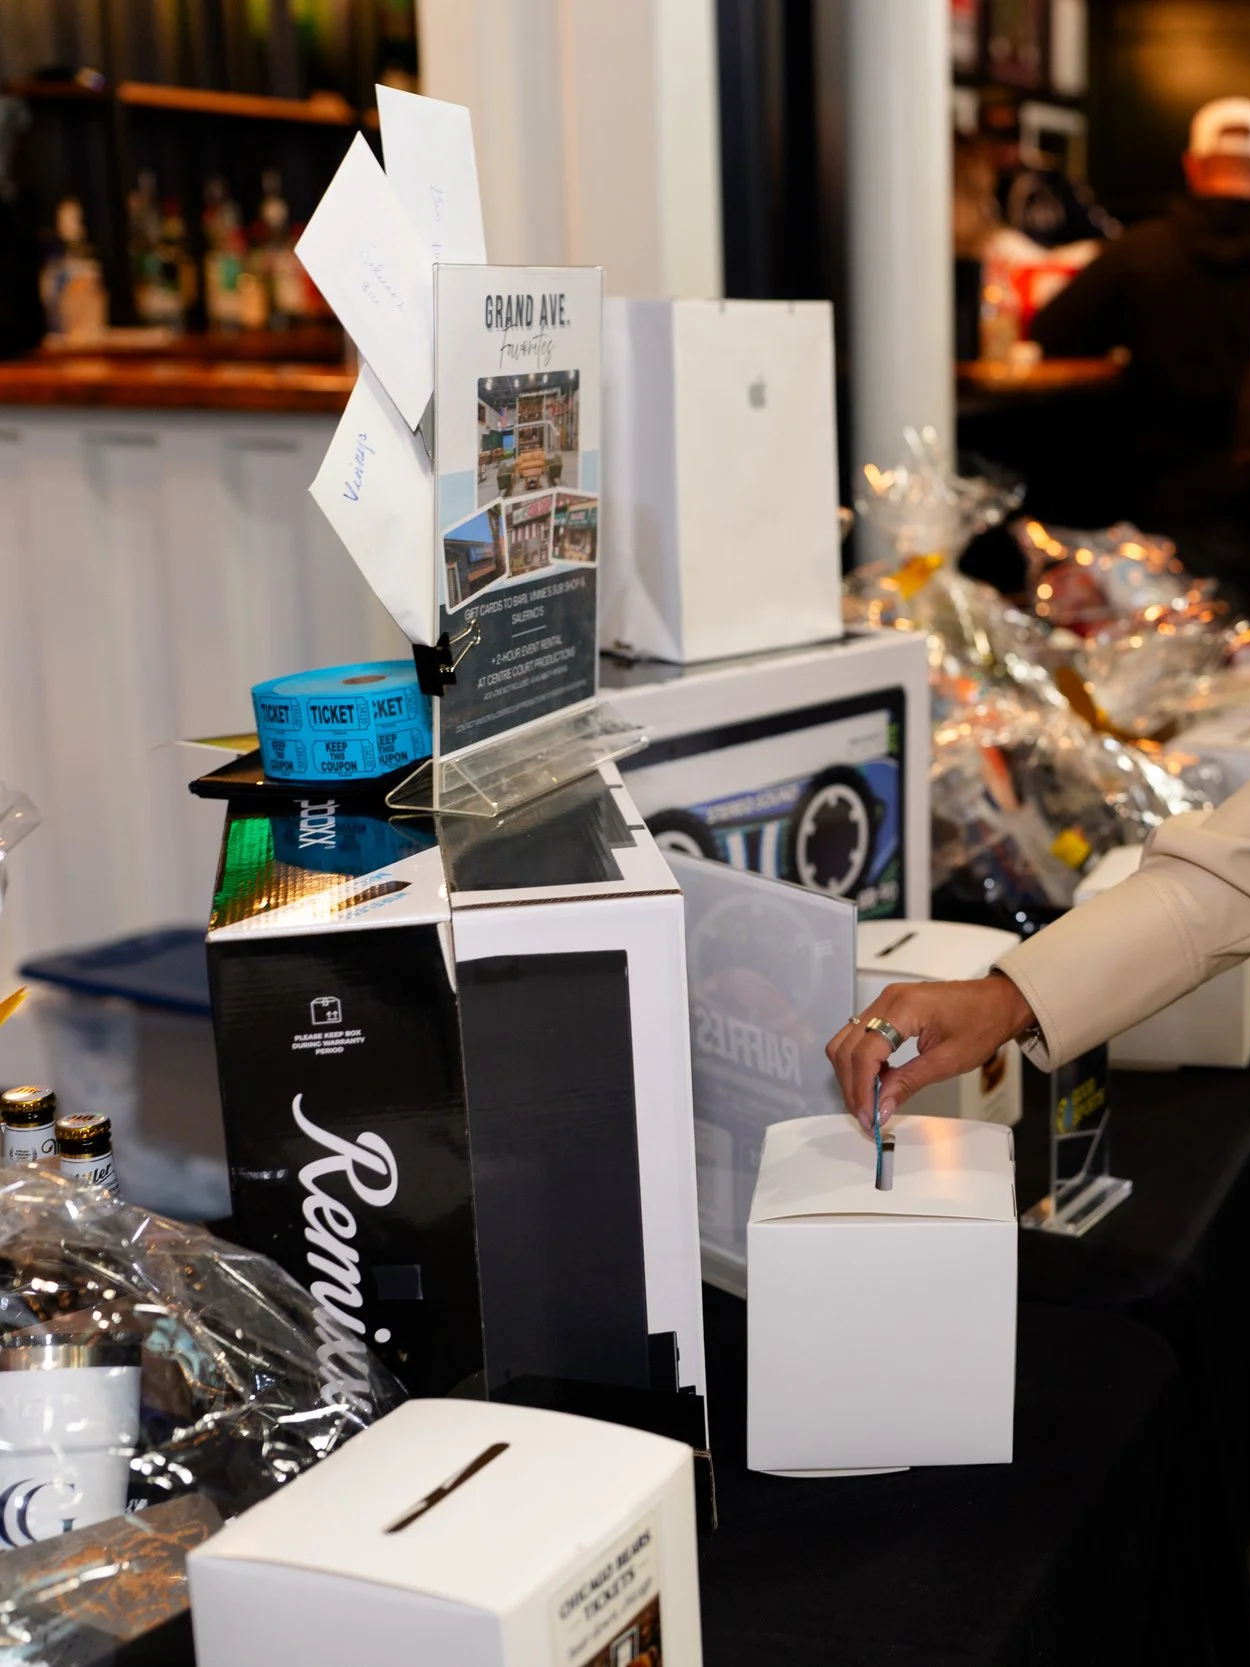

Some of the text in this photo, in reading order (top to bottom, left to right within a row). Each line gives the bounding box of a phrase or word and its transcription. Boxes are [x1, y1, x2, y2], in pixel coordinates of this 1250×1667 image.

[485, 294, 571, 329] GRAND AVE.
[464, 606, 480, 621] GIFT
[480, 600, 503, 616] CARDS
[503, 596, 513, 609] TO
[564, 578, 580, 592] SHOP
[521, 640, 541, 657] EVENT
[477, 677, 487, 689] AT
[487, 667, 512, 686] CENTRE
[512, 660, 534, 678] COURT
[261, 703, 289, 724] TICKET
[310, 705, 354, 724] TICKET
[377, 734, 397, 745] EEP
[325, 742, 347, 752] KEEP
[330, 752, 345, 761] THIS
[379, 751, 408, 765] UPON
[321, 761, 357, 772] COUPON
[294, 1029, 362, 1041] PLEASE KEEP BOX
[291, 1036, 365, 1050] DURING WARRANTY
[315, 1046, 344, 1055] PERIOD
